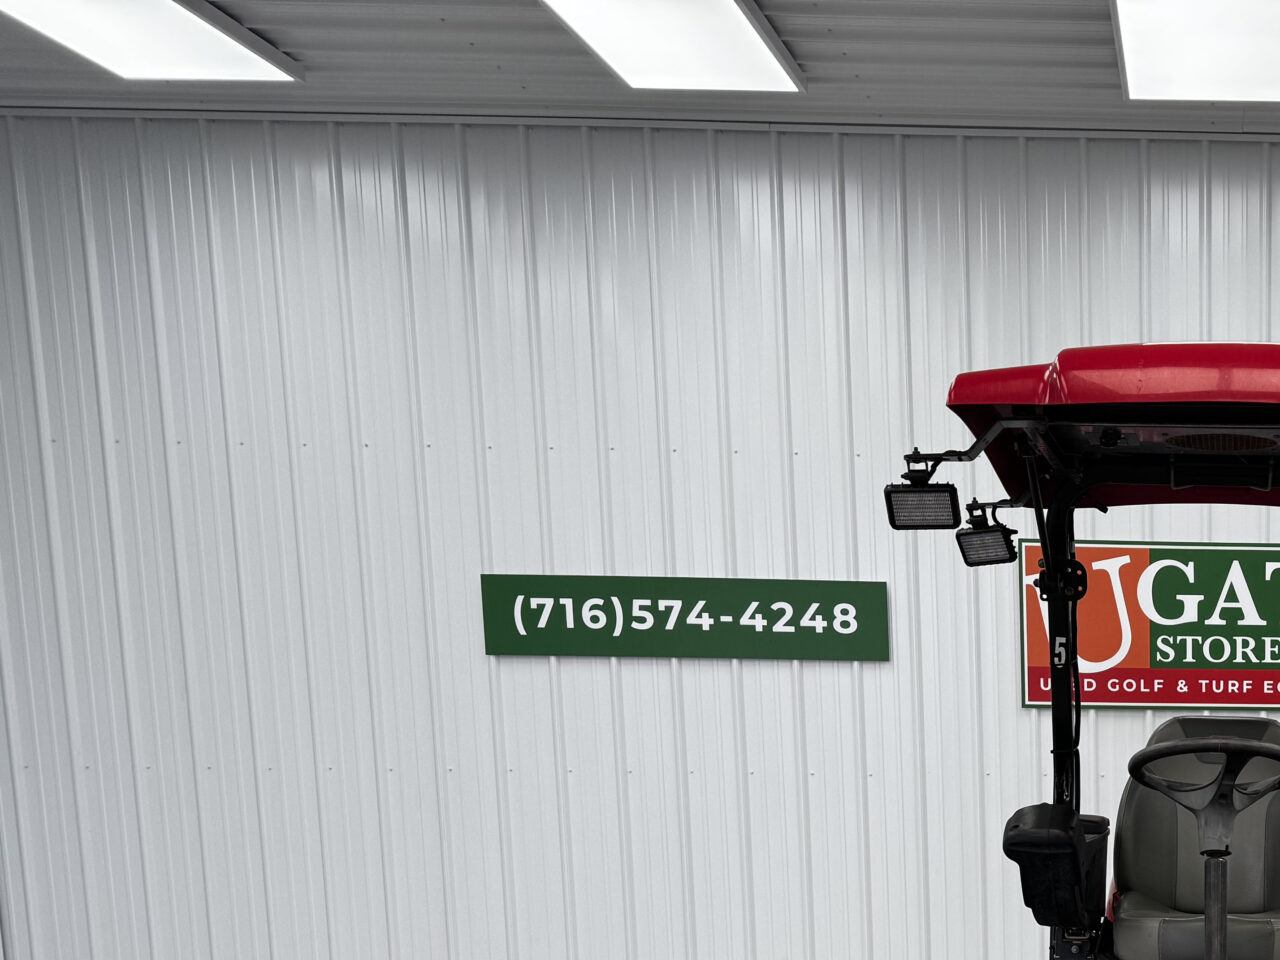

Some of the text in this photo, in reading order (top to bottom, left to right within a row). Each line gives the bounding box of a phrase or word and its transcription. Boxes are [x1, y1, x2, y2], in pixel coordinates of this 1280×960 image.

[513, 595, 858, 637] (716)574-4248
[1054, 636, 1067, 665] 5
[1040, 677, 1097, 692] UD
[1107, 678, 1164, 692] GOLF
[1176, 679, 1188, 693] &
[1198, 679, 1253, 693] TURF
